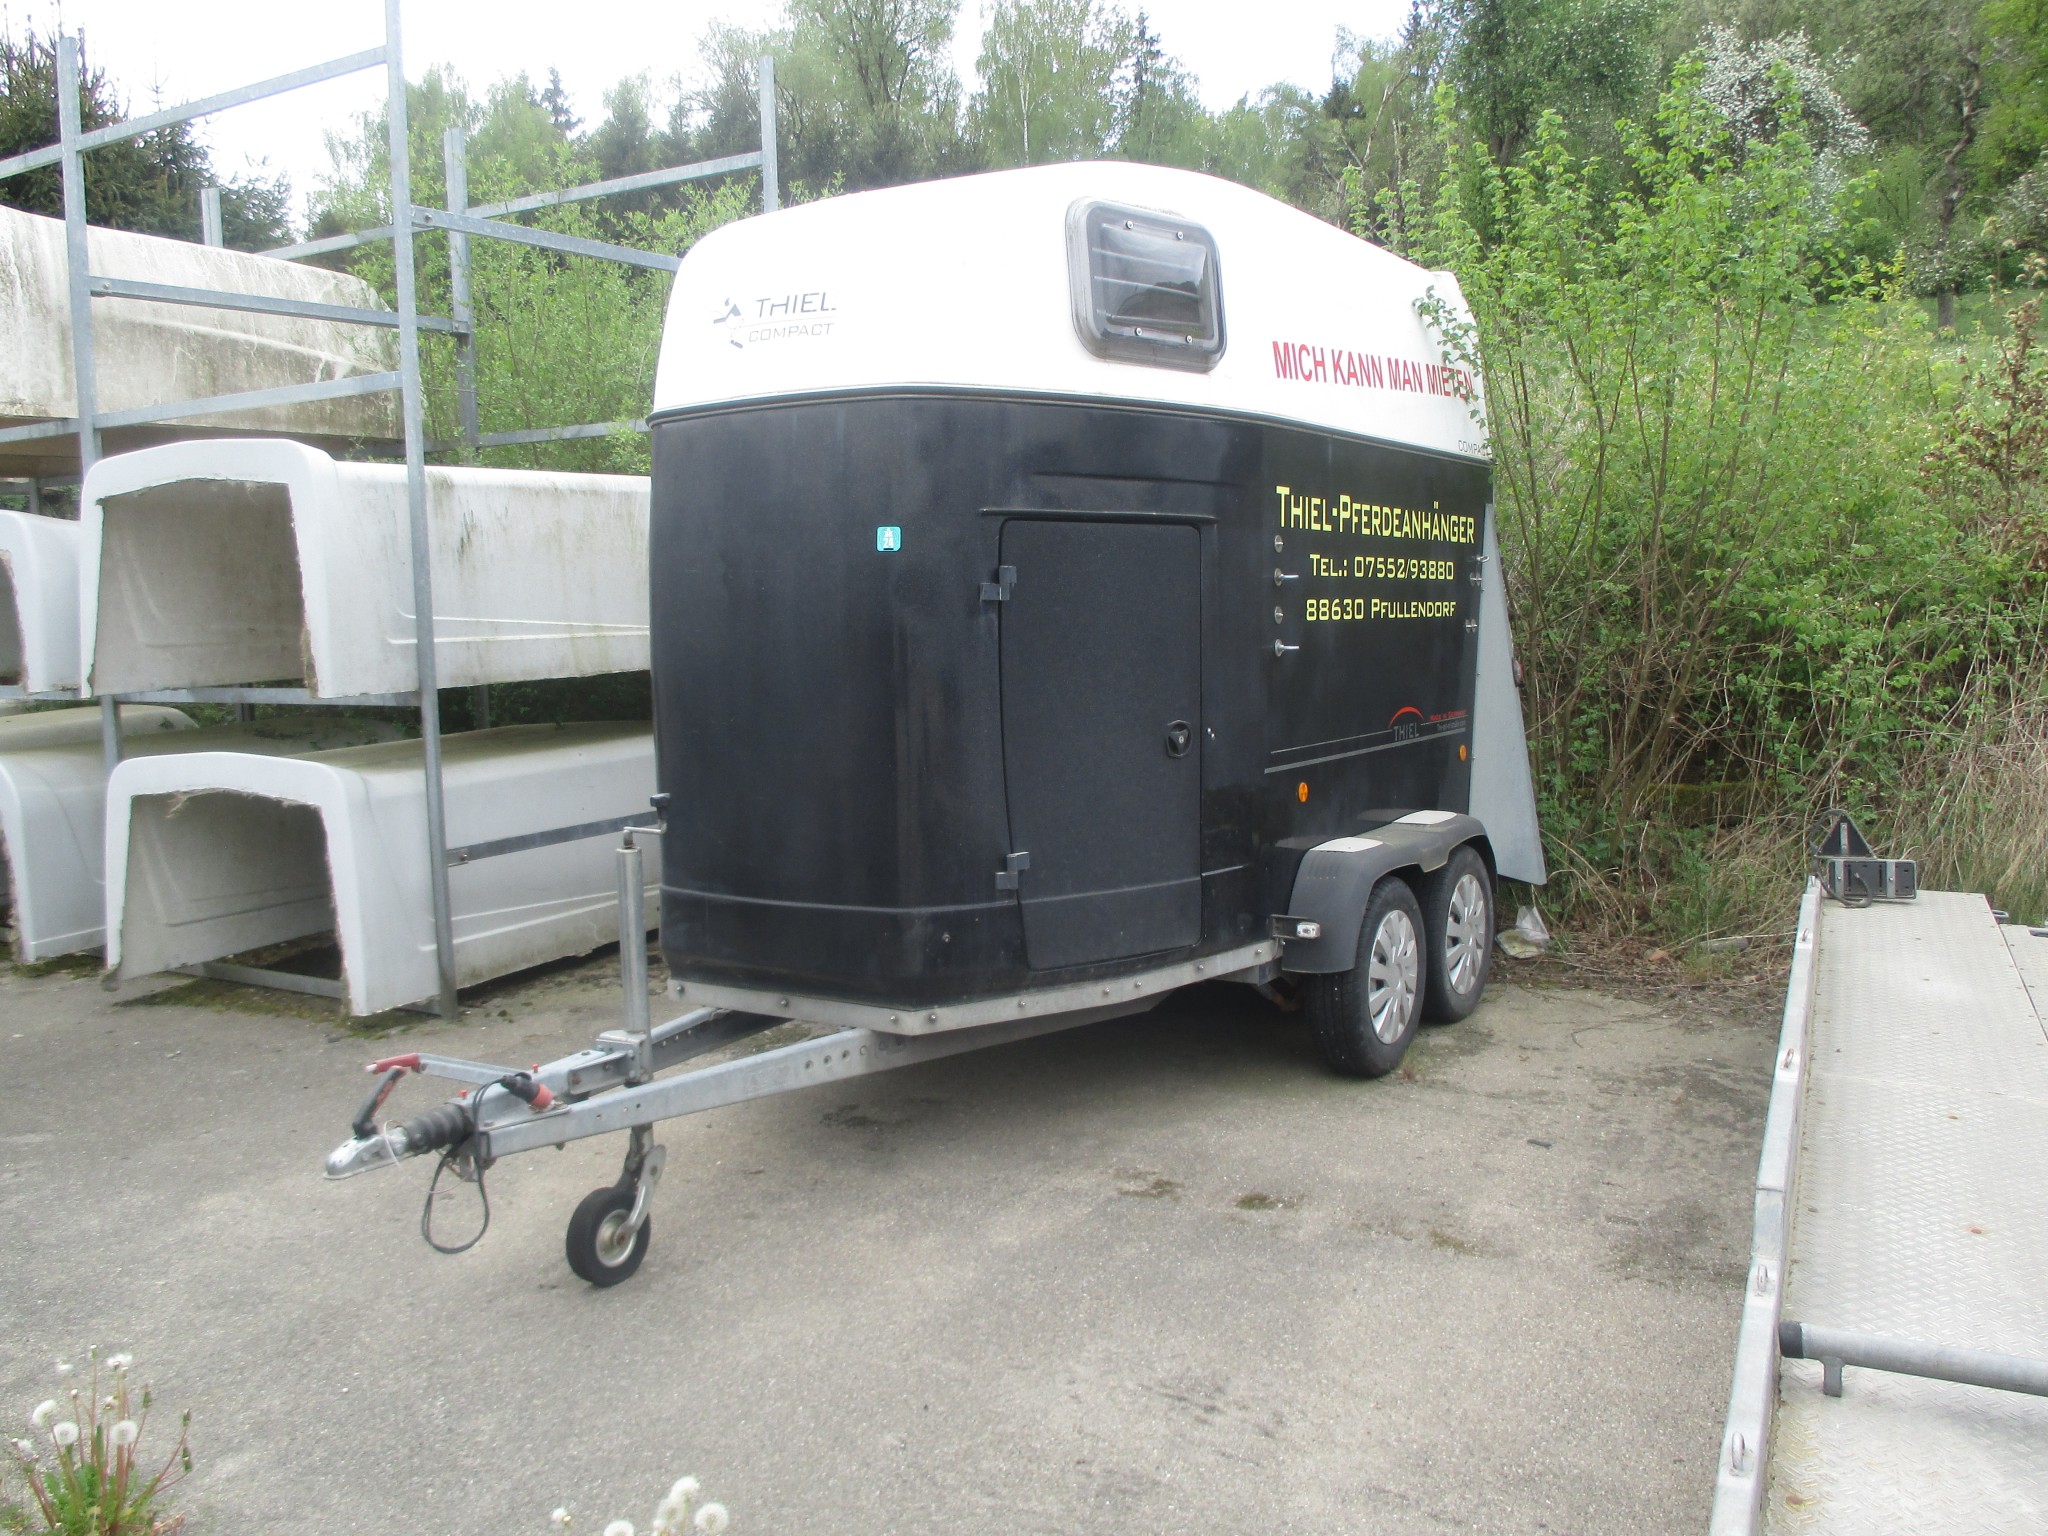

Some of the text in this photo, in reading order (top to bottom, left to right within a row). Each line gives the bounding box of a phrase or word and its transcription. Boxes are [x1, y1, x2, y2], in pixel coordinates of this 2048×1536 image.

[756, 292, 836, 318] THIEL
[749, 322, 835, 342] COMPACT
[1272, 341, 1327, 382] MICH
[1331, 349, 1384, 389] KANN
[1387, 357, 1423, 393] MAN
[1354, 556, 1454, 580] 07552/93880
[1306, 598, 1364, 621] 88630
[1393, 722, 1420, 742] THIEL
